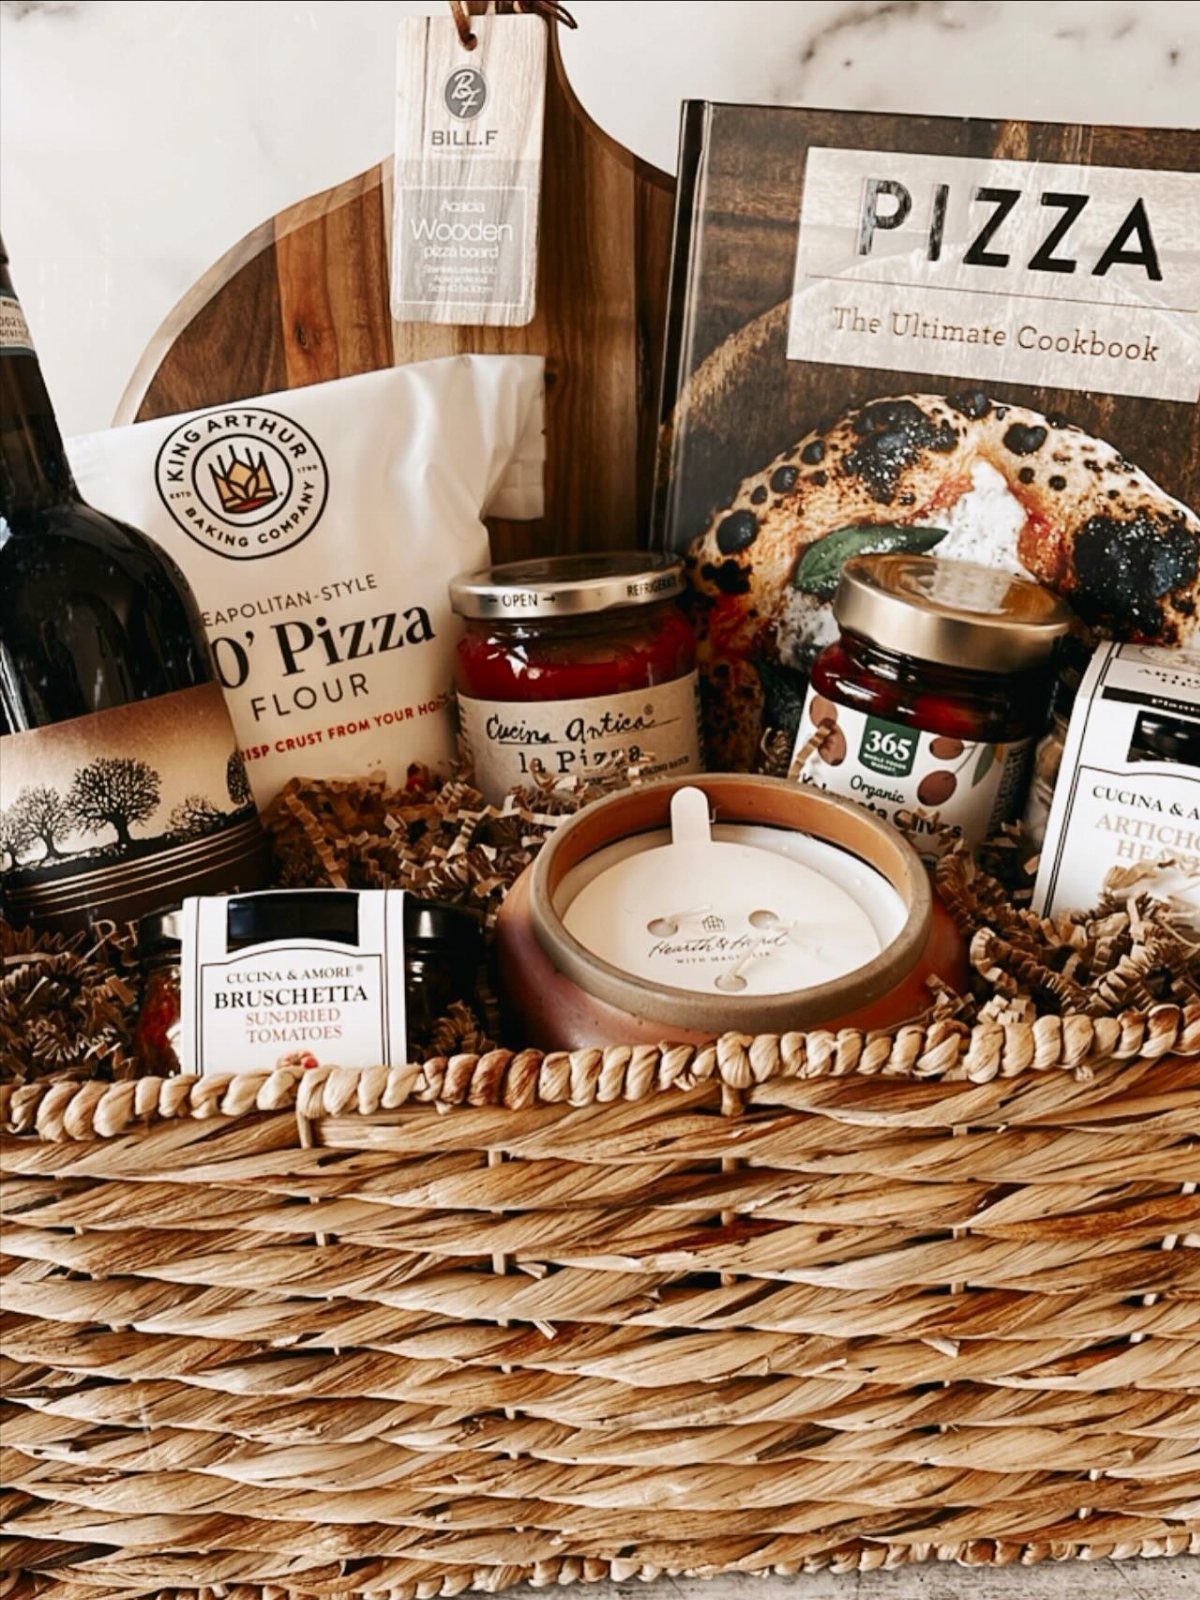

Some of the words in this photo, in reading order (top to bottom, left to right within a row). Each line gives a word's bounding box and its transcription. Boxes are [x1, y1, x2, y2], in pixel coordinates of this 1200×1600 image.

[432, 130, 499, 146] BILL.F
[410, 218, 513, 241] Wooden
[857, 178, 1163, 281] PIZZA
[424, 245, 457, 259] pizza
[459, 245, 499, 258] board
[833, 306, 881, 334] The
[891, 312, 1007, 346] Ultimate
[1017, 325, 1160, 362] Cookbook
[167, 429, 201, 482] KING
[207, 414, 307, 459] ARTHUR
[185, 507, 249, 547] BAKING
[257, 482, 315, 544] COMPANY
[201, 573, 378, 627] EAPOLITAN-STYLE
[502, 595, 538, 608] OPEN
[270, 605, 436, 677] Pizza
[250, 672, 369, 721] FLOUR
[275, 730, 323, 753] CRUST
[327, 717, 370, 740] FROM
[373, 708, 414, 728] YOUR
[486, 713, 557, 744] Cucina
[865, 730, 912, 762] 365
[850, 775, 905, 804] Organic
[1092, 784, 1163, 812] CUCINA
[1169, 802, 1184, 817] &
[226, 972, 282, 984] CUCINA
[287, 970, 298, 981] &
[302, 967, 353, 980] AMORE
[214, 985, 368, 1010] BRUSCHETTA
[246, 1025, 343, 1044] TOMATOES
